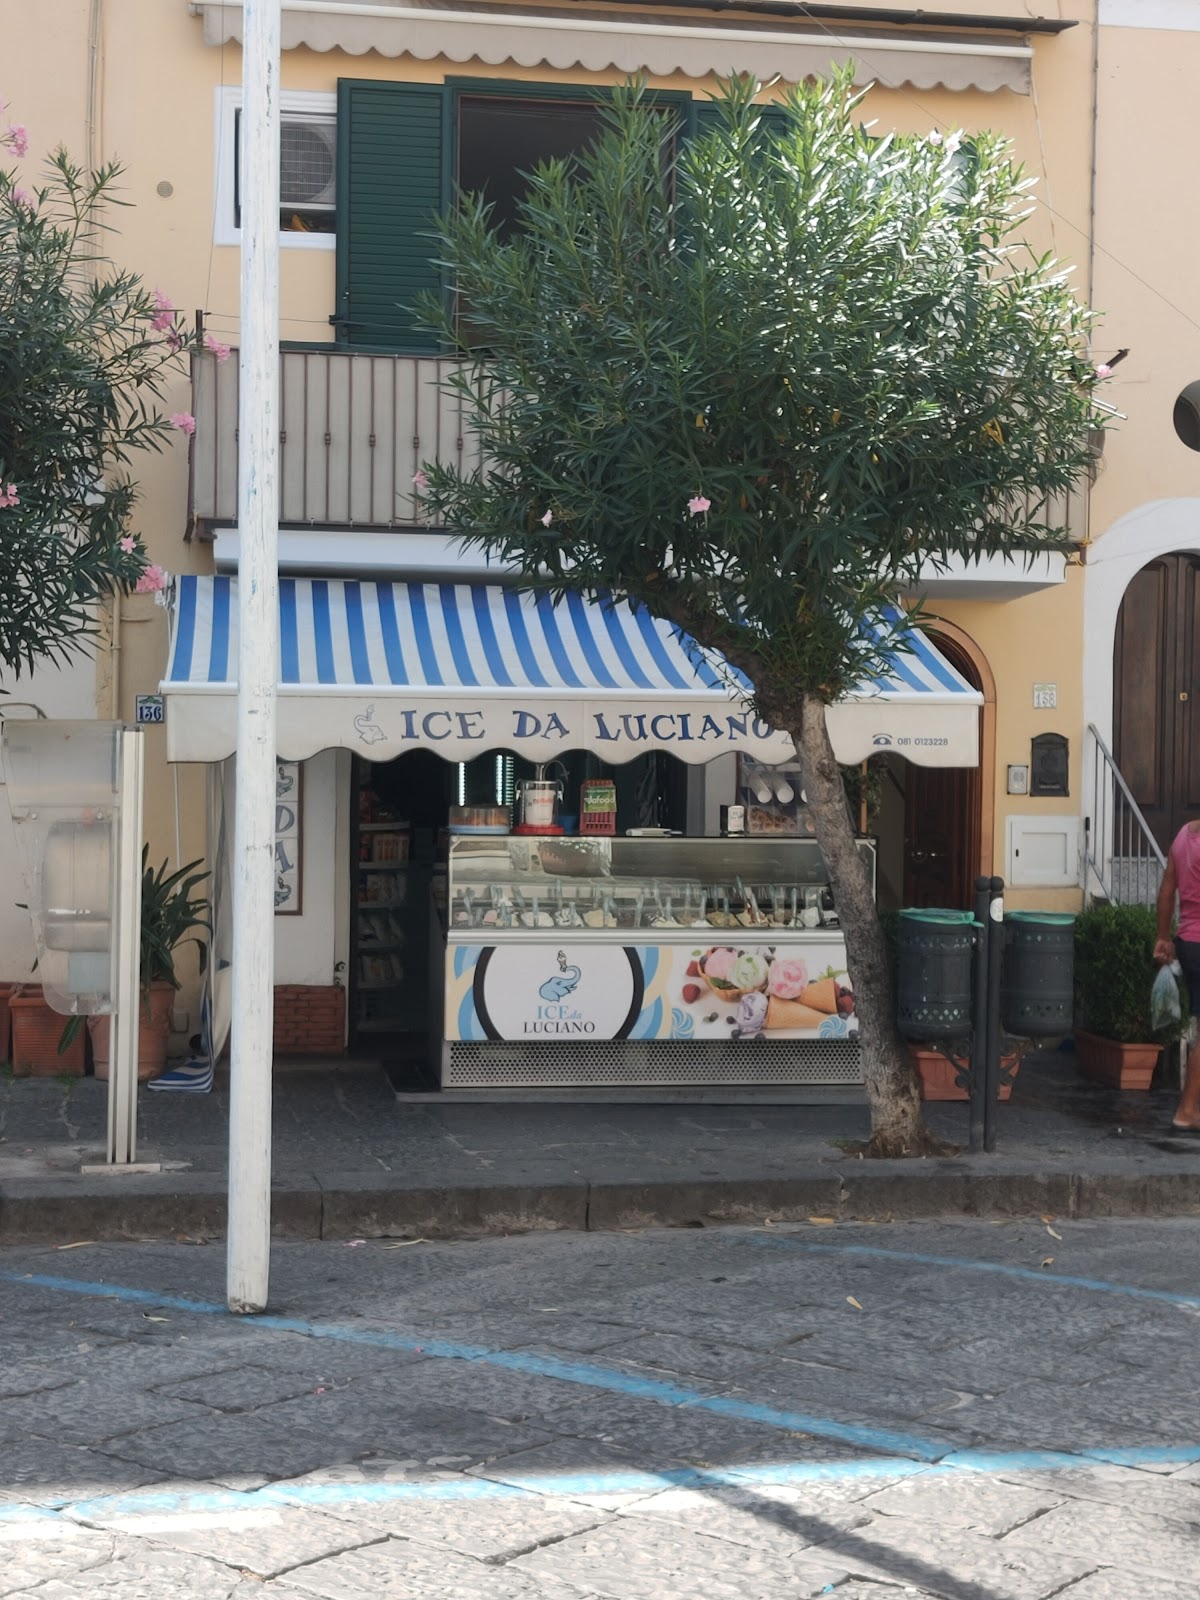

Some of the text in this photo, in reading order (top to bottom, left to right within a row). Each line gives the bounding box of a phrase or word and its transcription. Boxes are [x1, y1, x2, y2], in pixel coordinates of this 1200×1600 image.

[1036, 692, 1055, 706] 138
[139, 706, 161, 721] 136
[400, 709, 775, 742] ICE DA LUCIANO
[537, 1005, 569, 1019] ICE
[523, 1021, 595, 1033] LUCIANO
